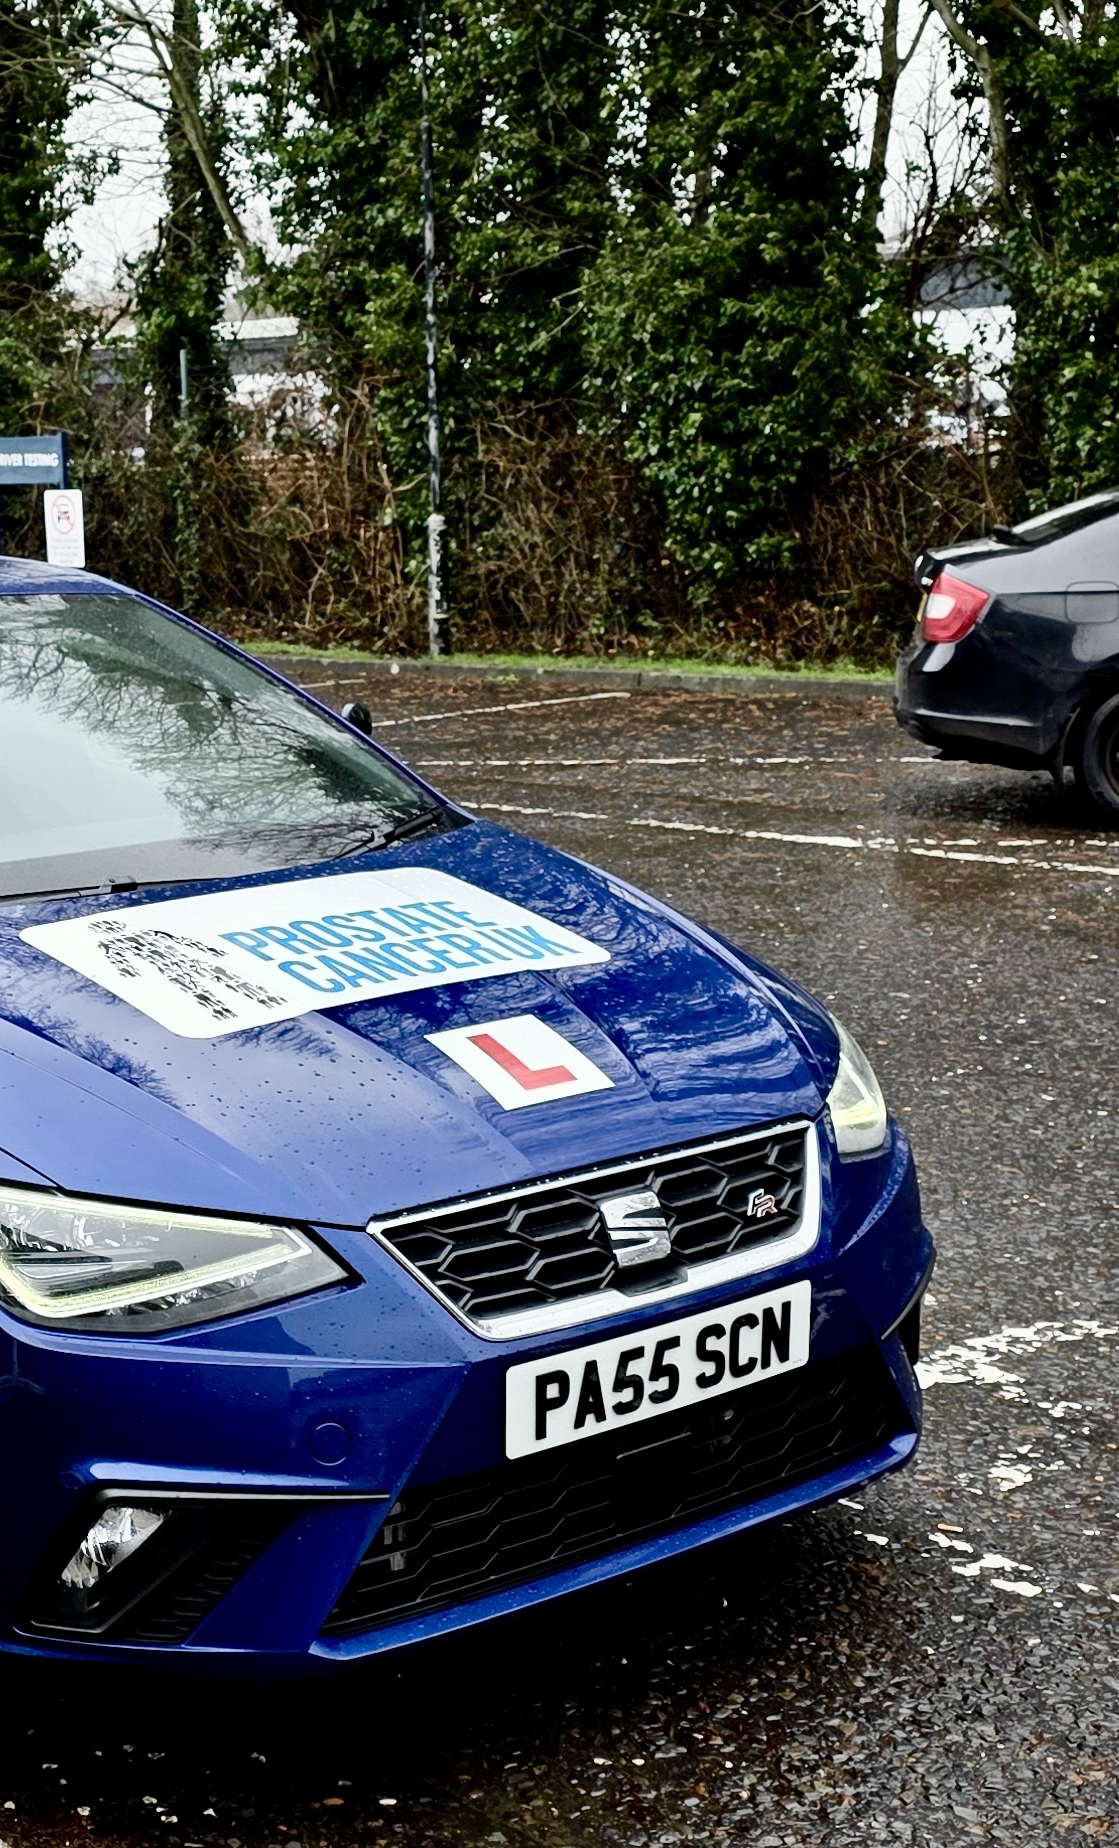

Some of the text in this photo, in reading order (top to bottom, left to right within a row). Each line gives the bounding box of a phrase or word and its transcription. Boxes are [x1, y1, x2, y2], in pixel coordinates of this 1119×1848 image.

[24, 452, 59, 467] TESTING
[218, 900, 499, 962] PROSTATE
[277, 925, 583, 993] CANCER UK
[465, 1033, 578, 1091] L
[534, 1299, 792, 1441] PA55 SCN
